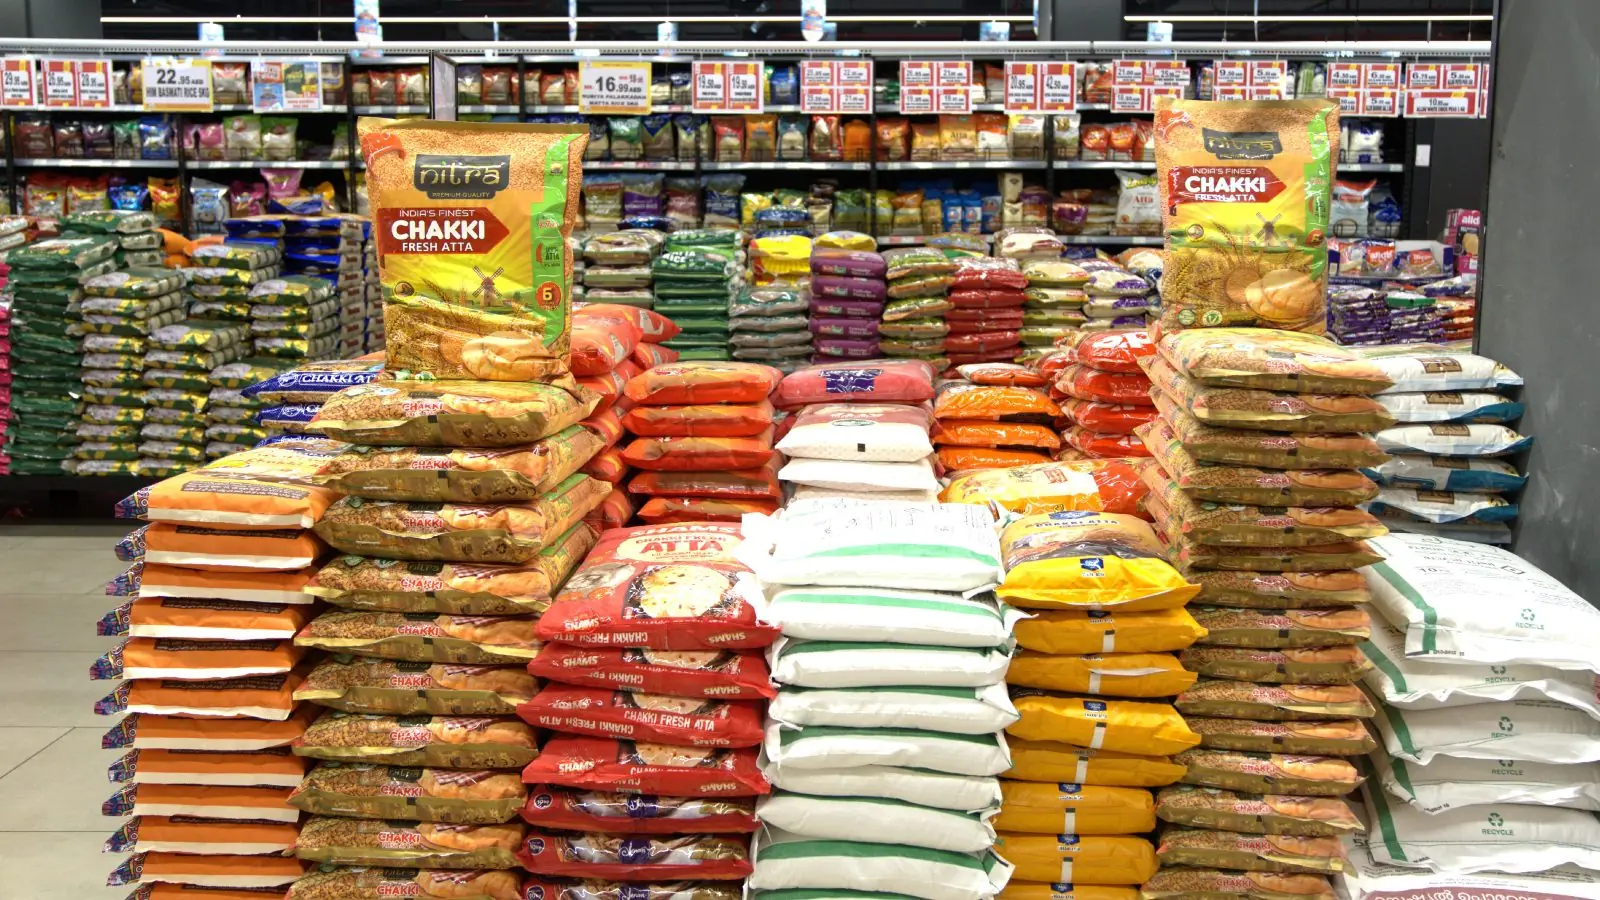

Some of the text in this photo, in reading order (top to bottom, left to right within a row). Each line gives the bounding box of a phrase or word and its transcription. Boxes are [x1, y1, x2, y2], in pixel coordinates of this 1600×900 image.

[595, 76, 629, 92] 16.99
[158, 87, 183, 97] BASMATI
[184, 88, 197, 97] RICE
[420, 162, 504, 185] nitra
[1192, 167, 1223, 175] INDIA'S
[1184, 176, 1266, 193] CHAKKI
[399, 209, 475, 218] INDIA'S FINEST
[391, 219, 485, 240] CHAKKI
[402, 242, 473, 252] FRESH ATTA
[302, 373, 352, 383] CHAKKI
[402, 403, 443, 411] CHAKKI
[404, 519, 443, 527] CHAKKI
[640, 540, 723, 554] ATTA
[401, 578, 443, 589] CHAKKI
[396, 626, 440, 636] CHAKKI
[1515, 622, 1545, 630] RECYCLE
[612, 632, 648, 643] CHAKKI
[708, 632, 746, 644] SHAMS
[562, 655, 599, 668] SHAMS
[389, 676, 432, 687] CHAKKI
[703, 686, 741, 695] SHAMS
[539, 715, 562, 725] ATTA
[623, 710, 715, 732] CHAKKI FRESH ATTA
[599, 721, 634, 734] CHAKKI
[389, 731, 432, 742] CHAKKI
[558, 759, 595, 773] SHAMS
[380, 785, 424, 797] CHAKKI
[700, 783, 737, 792] SHAMS
[1481, 828, 1515, 836] RECYCLE
[377, 832, 421, 844] CHAKKI
[1236, 841, 1271, 849] CHAKKI
[1216, 879, 1251, 887] CHAKKI
[376, 885, 420, 896] CHAKKI
